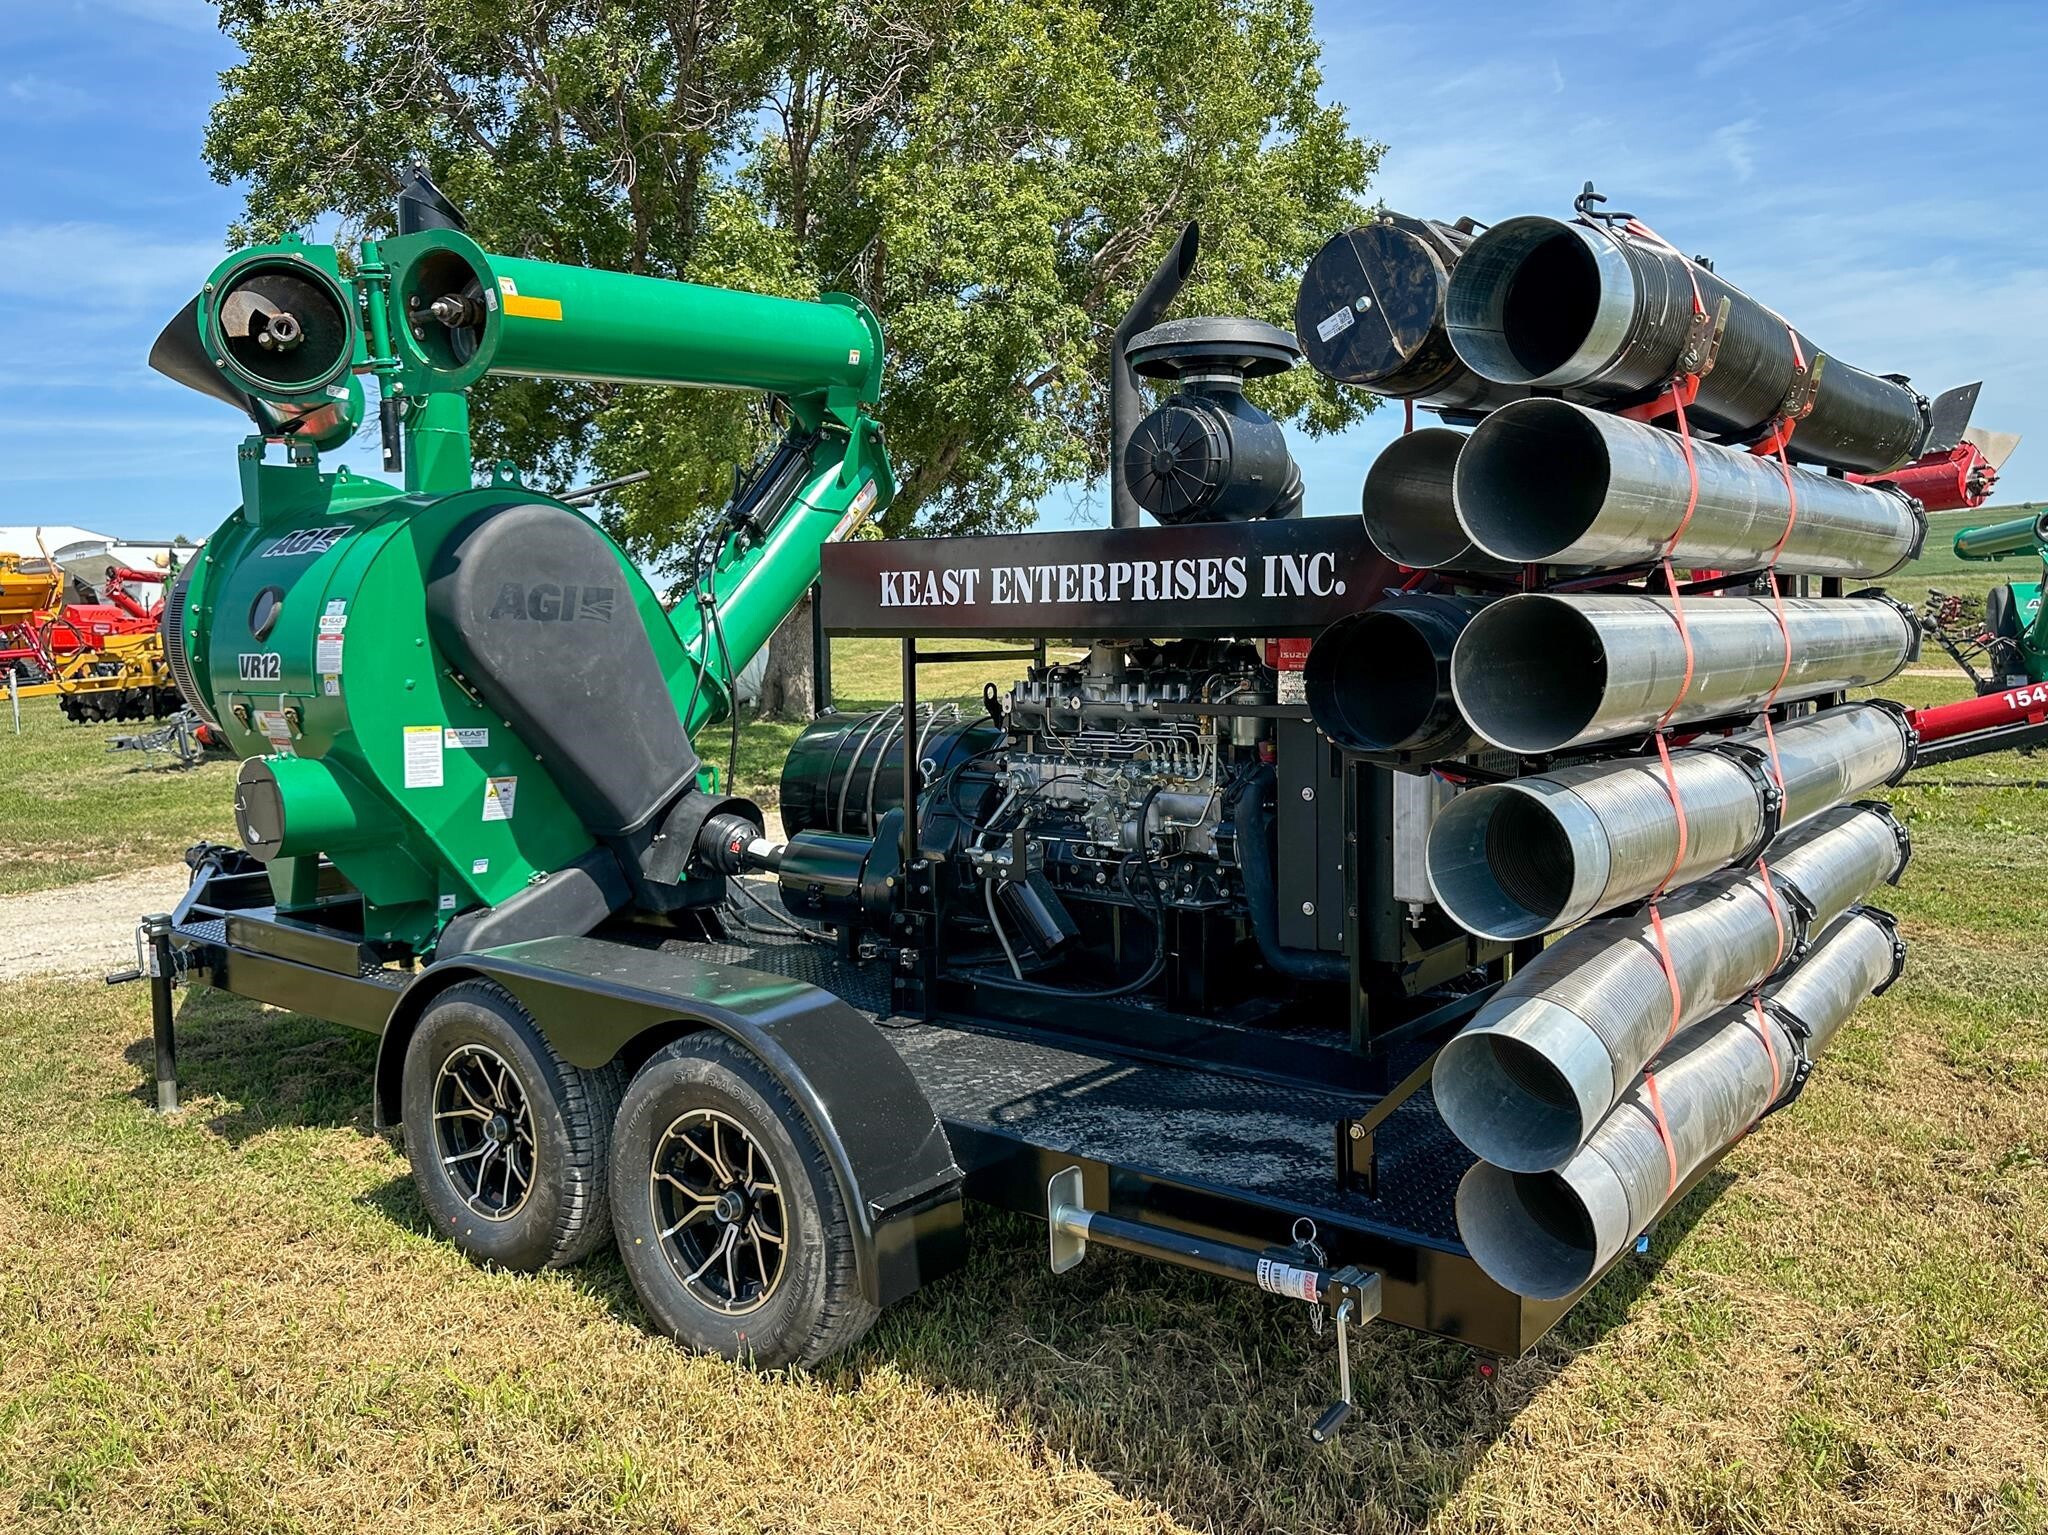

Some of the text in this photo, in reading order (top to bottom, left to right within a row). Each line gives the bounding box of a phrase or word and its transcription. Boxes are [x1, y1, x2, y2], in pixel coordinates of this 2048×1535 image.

[261, 527, 333, 557] AGI
[880, 552, 1346, 607] KEAST ENTERPRISES INC.
[489, 582, 578, 622] AGI
[239, 653, 281, 680] VR12
[1280, 651, 1308, 659] ISUZU
[2003, 685, 2048, 710] 154
[674, 1068, 770, 1129] ST RADIAL
